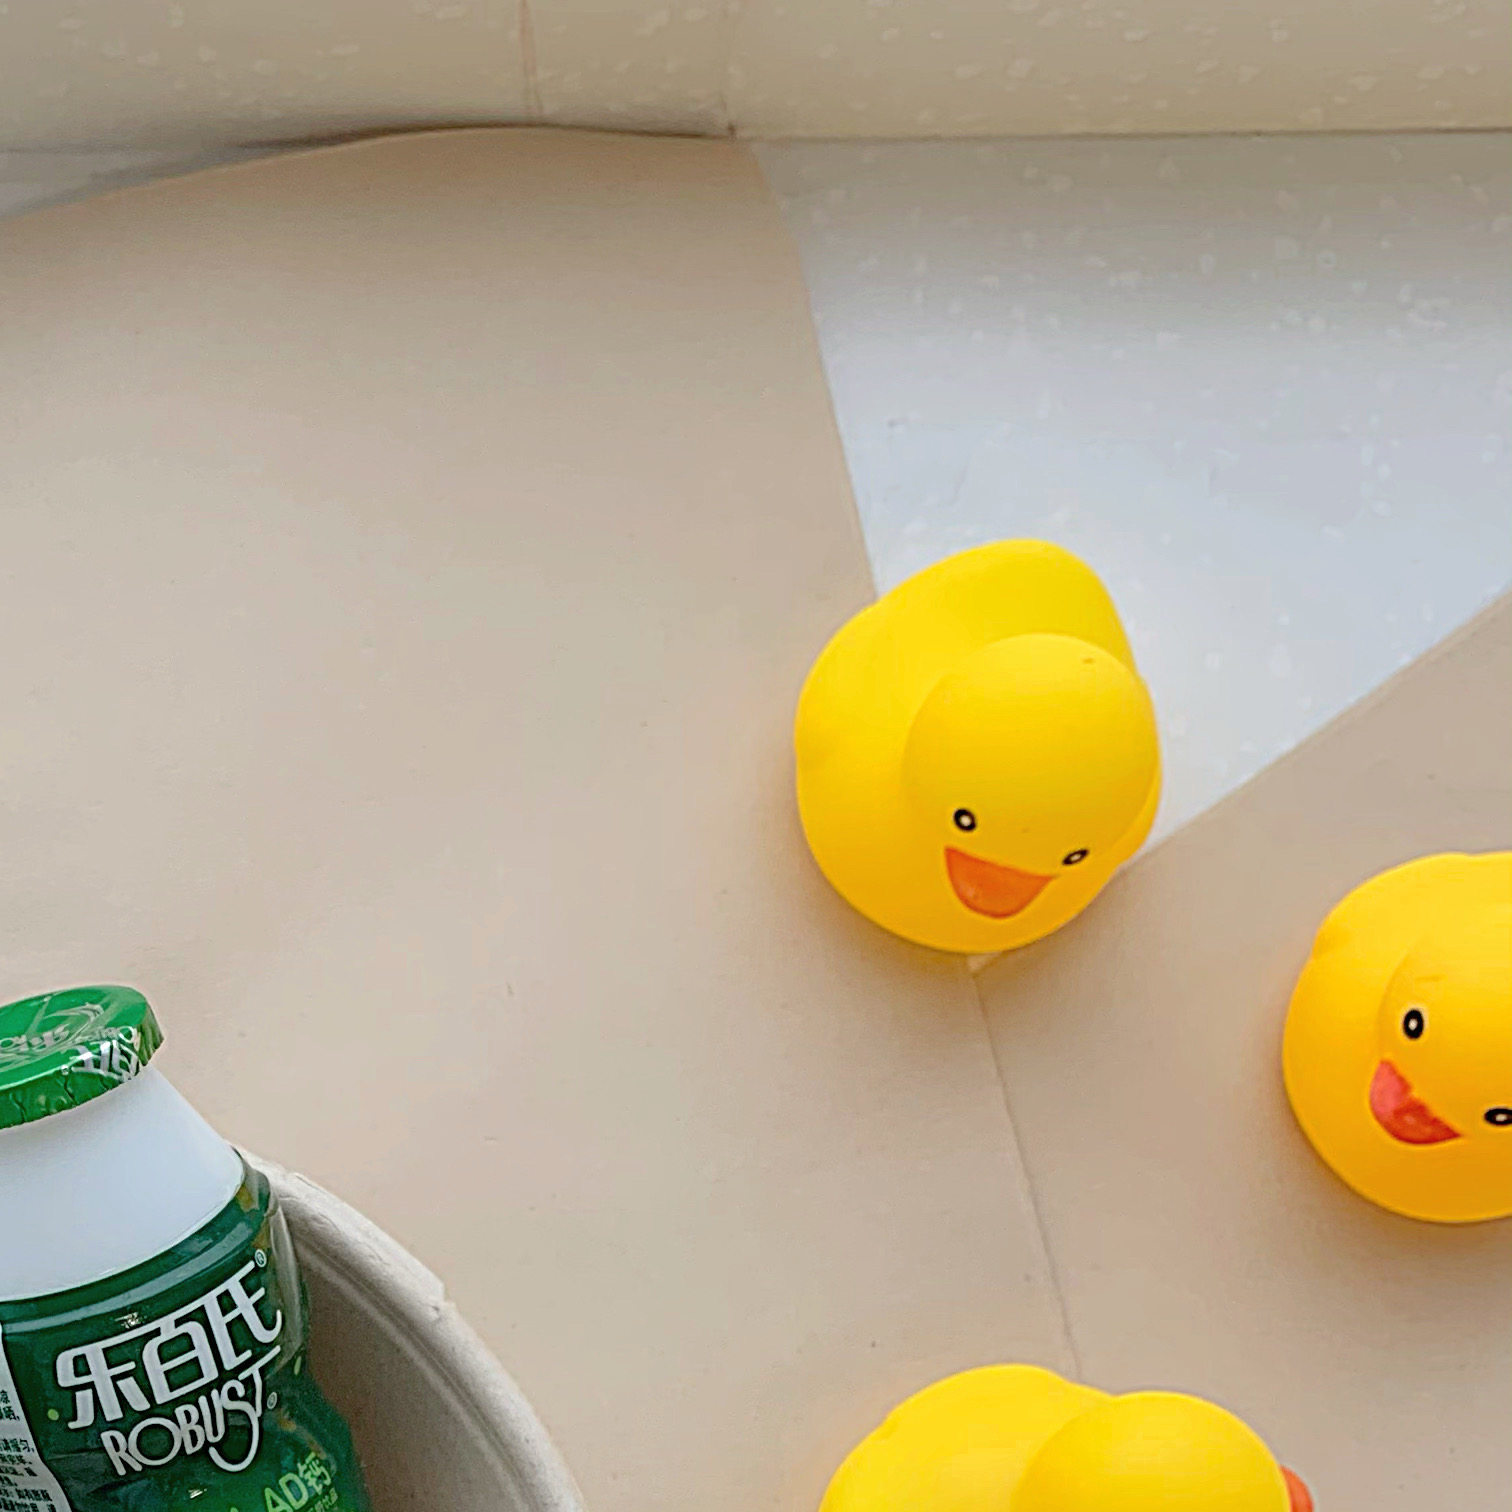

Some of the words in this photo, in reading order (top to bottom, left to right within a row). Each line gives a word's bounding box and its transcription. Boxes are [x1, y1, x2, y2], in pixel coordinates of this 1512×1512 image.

[55, 1260, 282, 1430] 乐百氏
[101, 1346, 281, 1475] ROBUST
